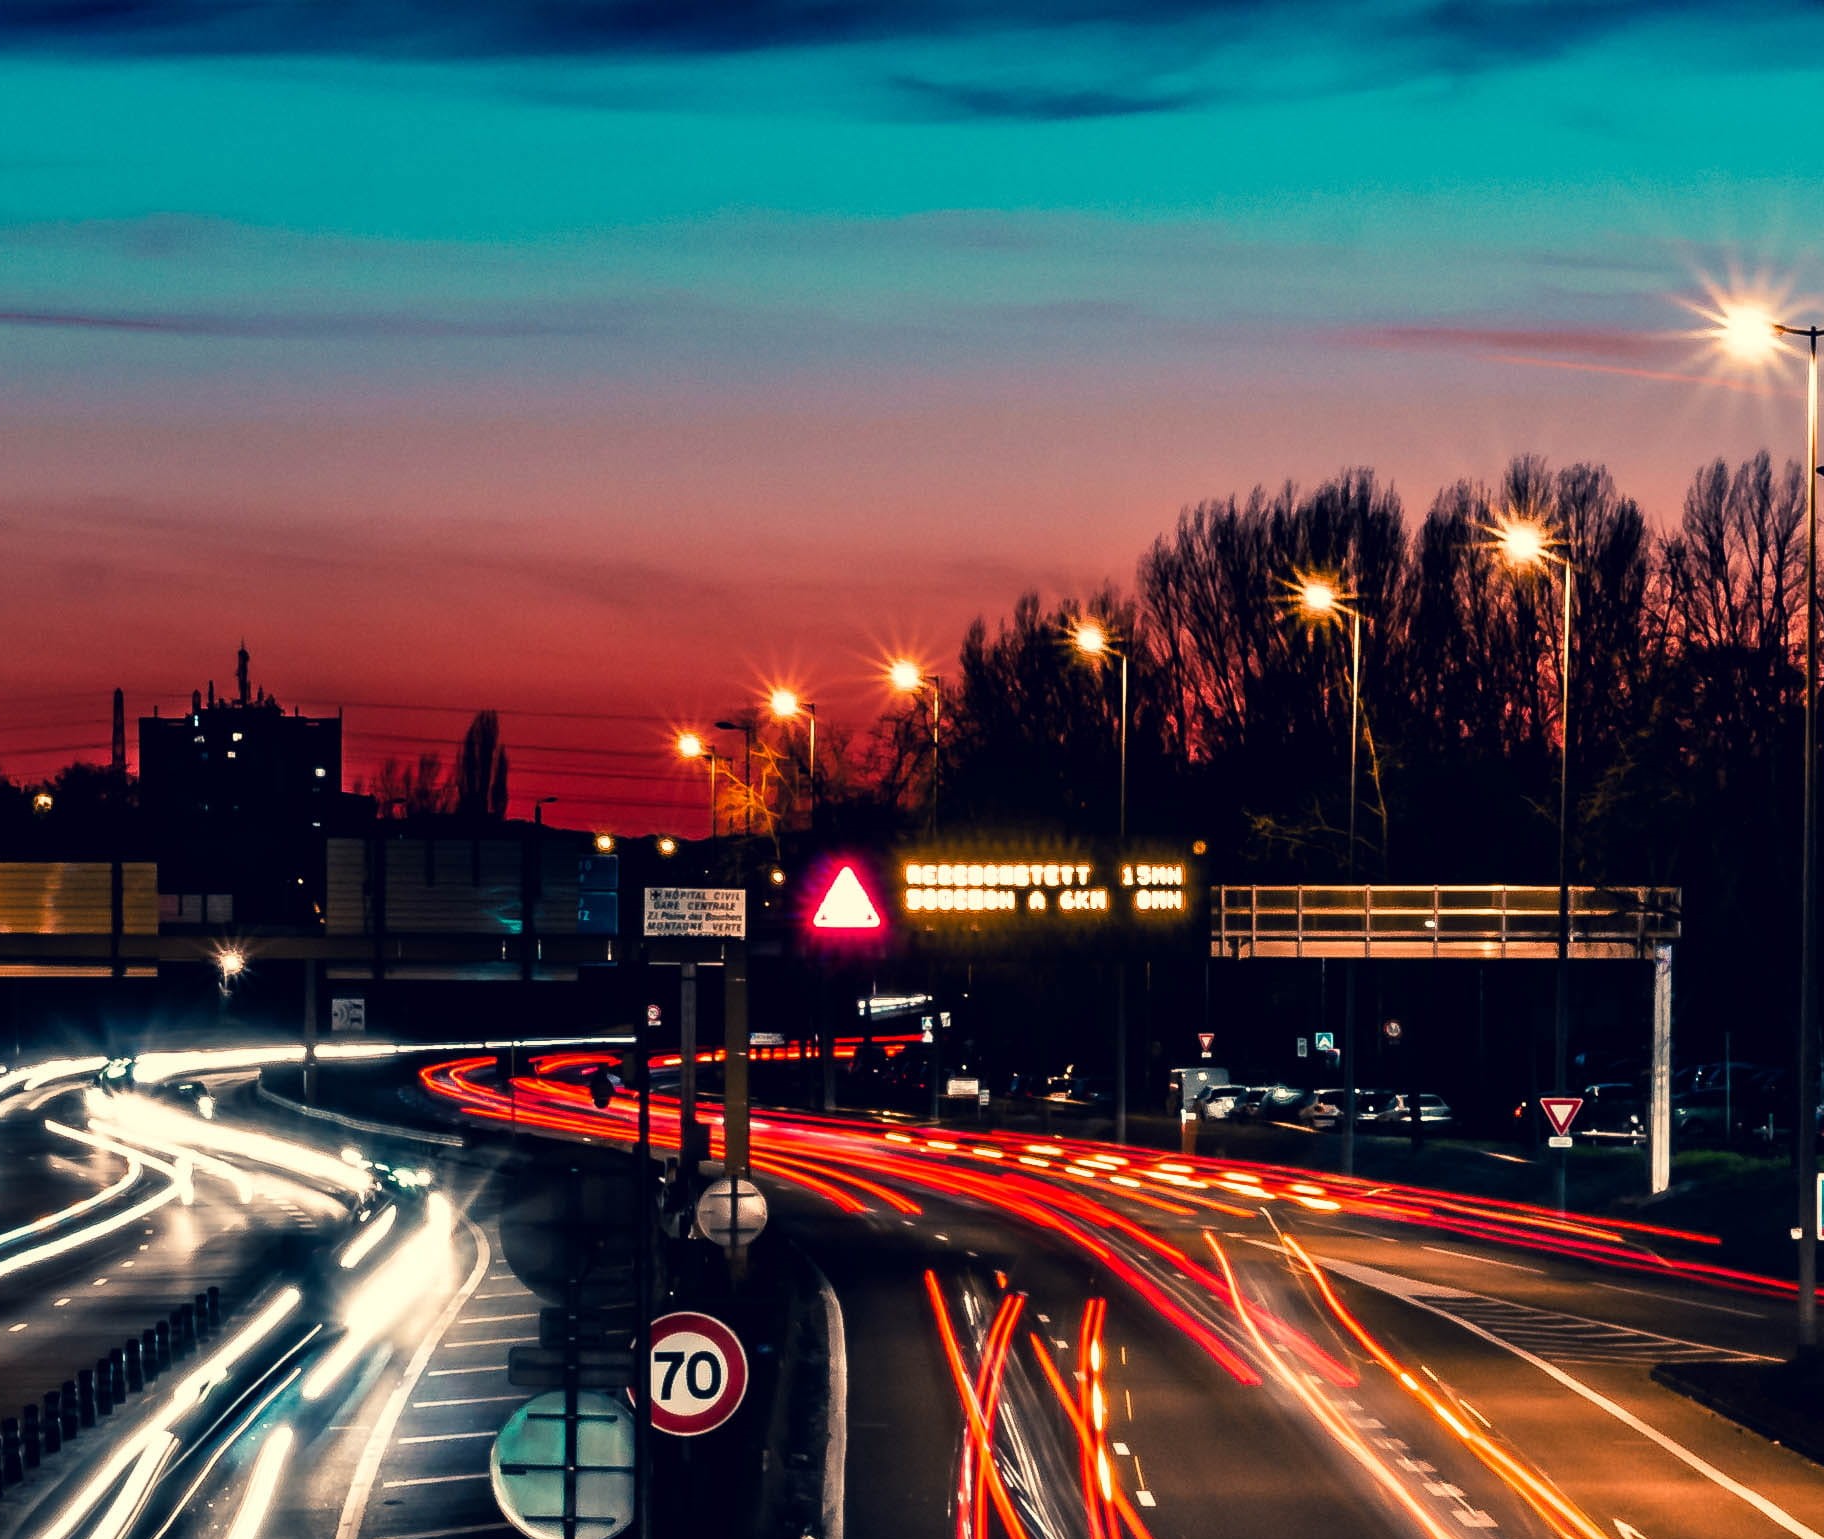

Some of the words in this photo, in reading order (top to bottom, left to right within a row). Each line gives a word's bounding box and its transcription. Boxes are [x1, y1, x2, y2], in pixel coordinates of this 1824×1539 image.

[714, 891, 741, 901] CIVIL
[654, 902, 679, 910] GARE
[687, 902, 735, 911] CENTRALE
[712, 923, 742, 932] VERTE
[654, 1351, 722, 1401] 70
